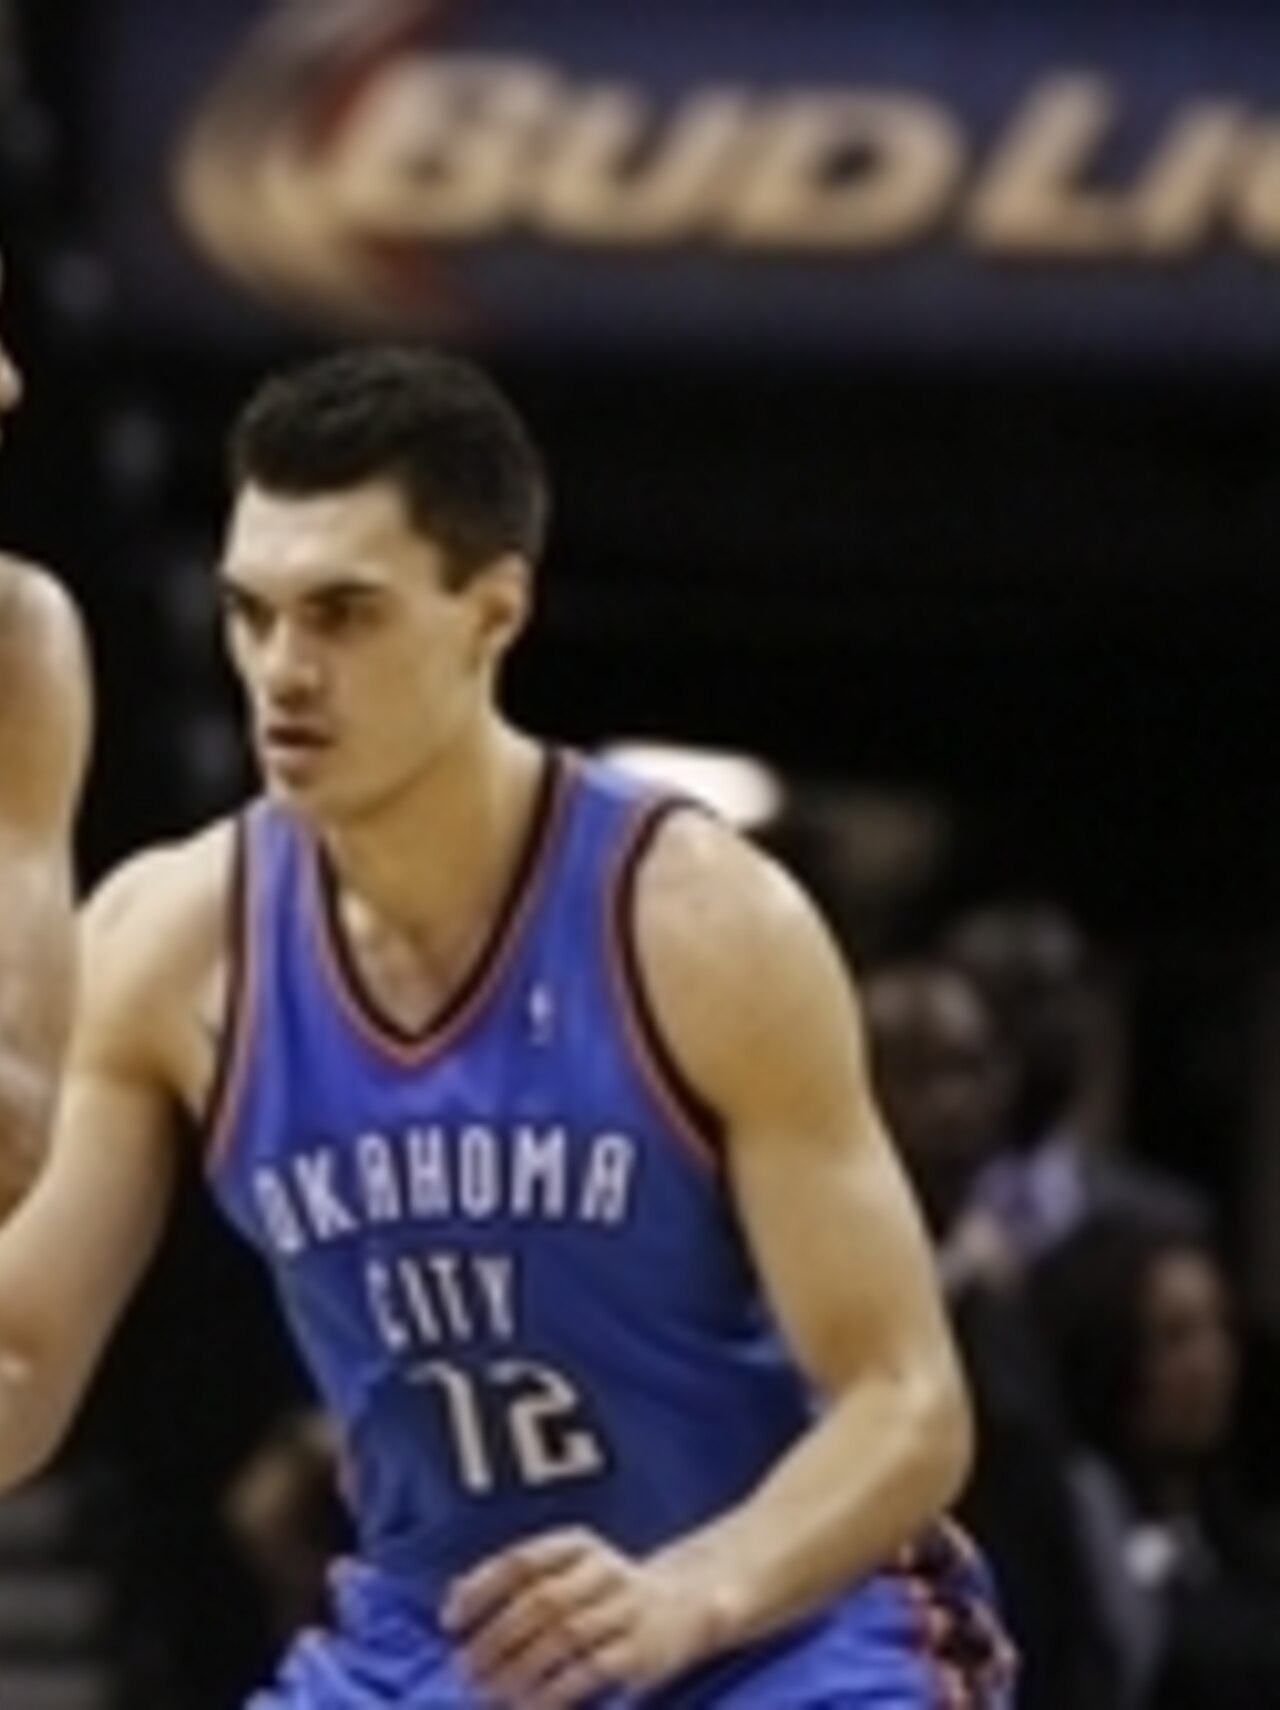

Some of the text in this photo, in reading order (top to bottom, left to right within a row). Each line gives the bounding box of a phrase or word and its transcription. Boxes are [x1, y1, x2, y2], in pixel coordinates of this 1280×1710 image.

[332, 56, 1280, 254] BUD LI
[364, 1253, 515, 1351] CITY
[408, 1359, 604, 1493] 12
